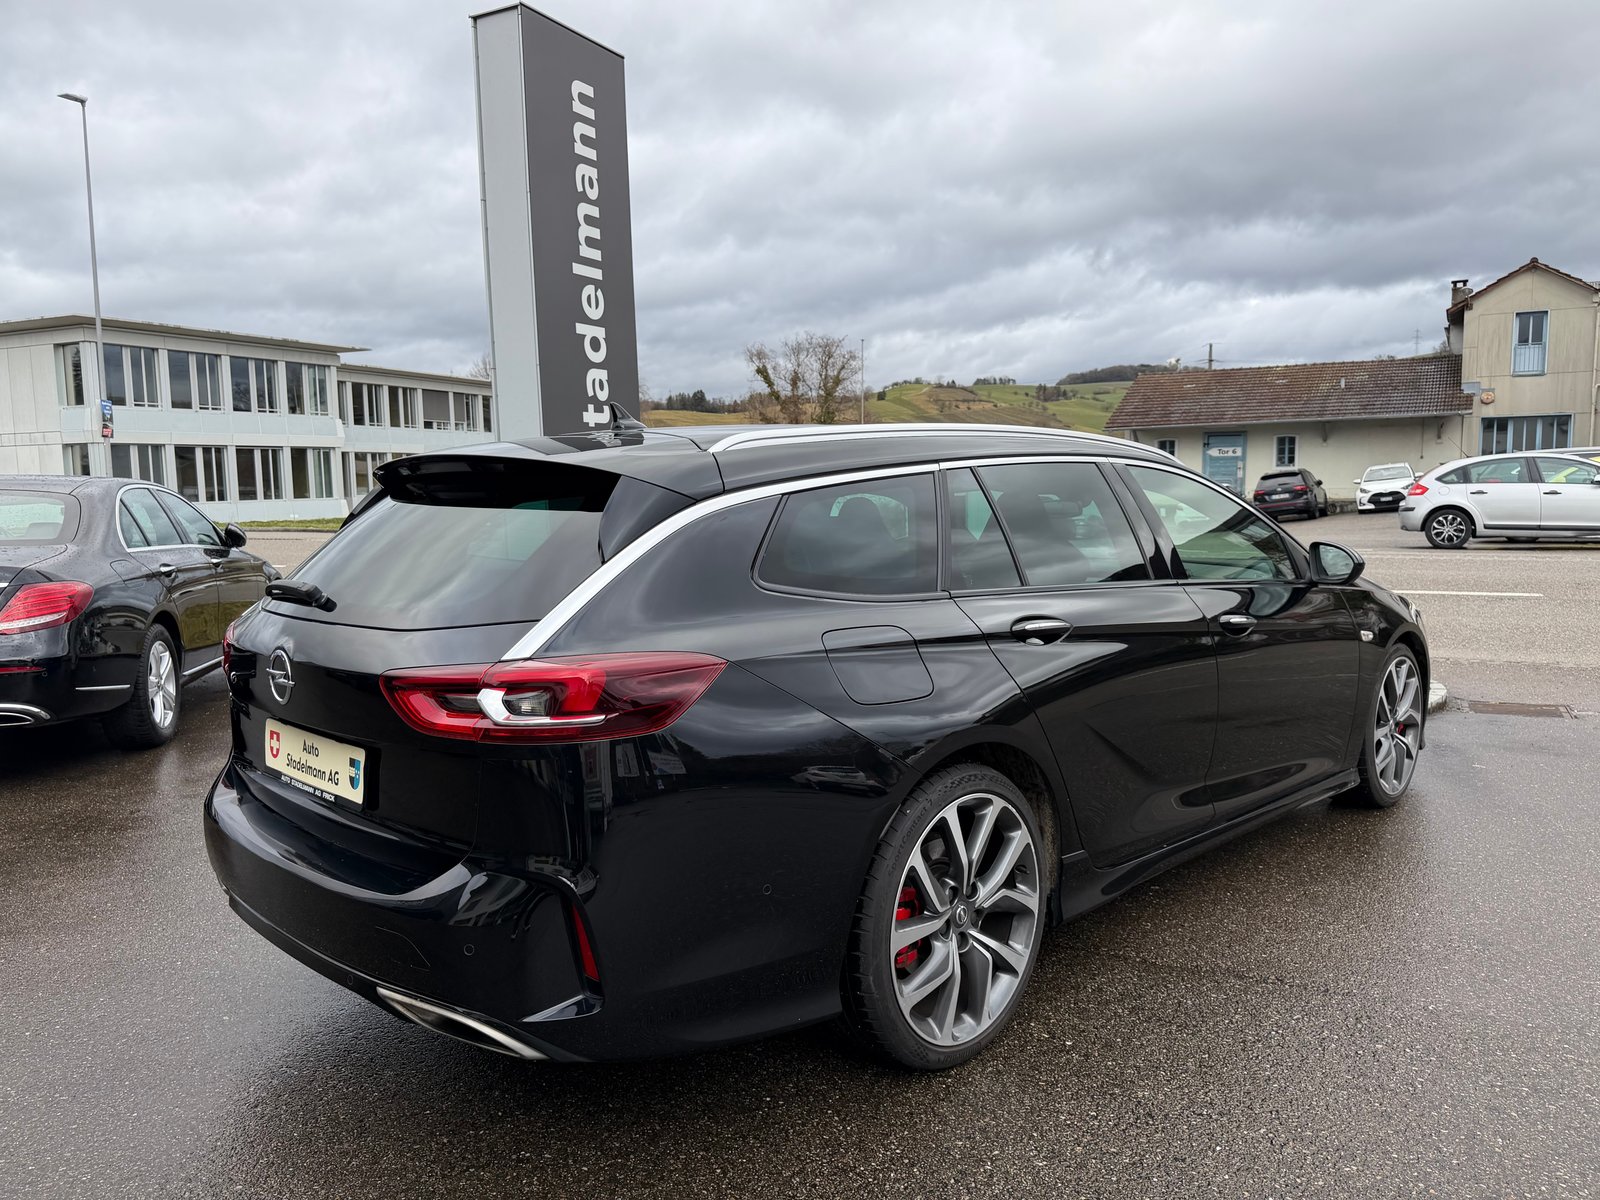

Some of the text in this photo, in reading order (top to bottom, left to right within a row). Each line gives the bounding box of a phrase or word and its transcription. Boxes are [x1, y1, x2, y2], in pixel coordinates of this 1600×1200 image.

[571, 80, 610, 427] tadelmann
[302, 739, 320, 758] Auto
[286, 753, 340, 786] Stadelmann AG
[281, 775, 335, 802] AUTO STADELMANN AG FRICK
